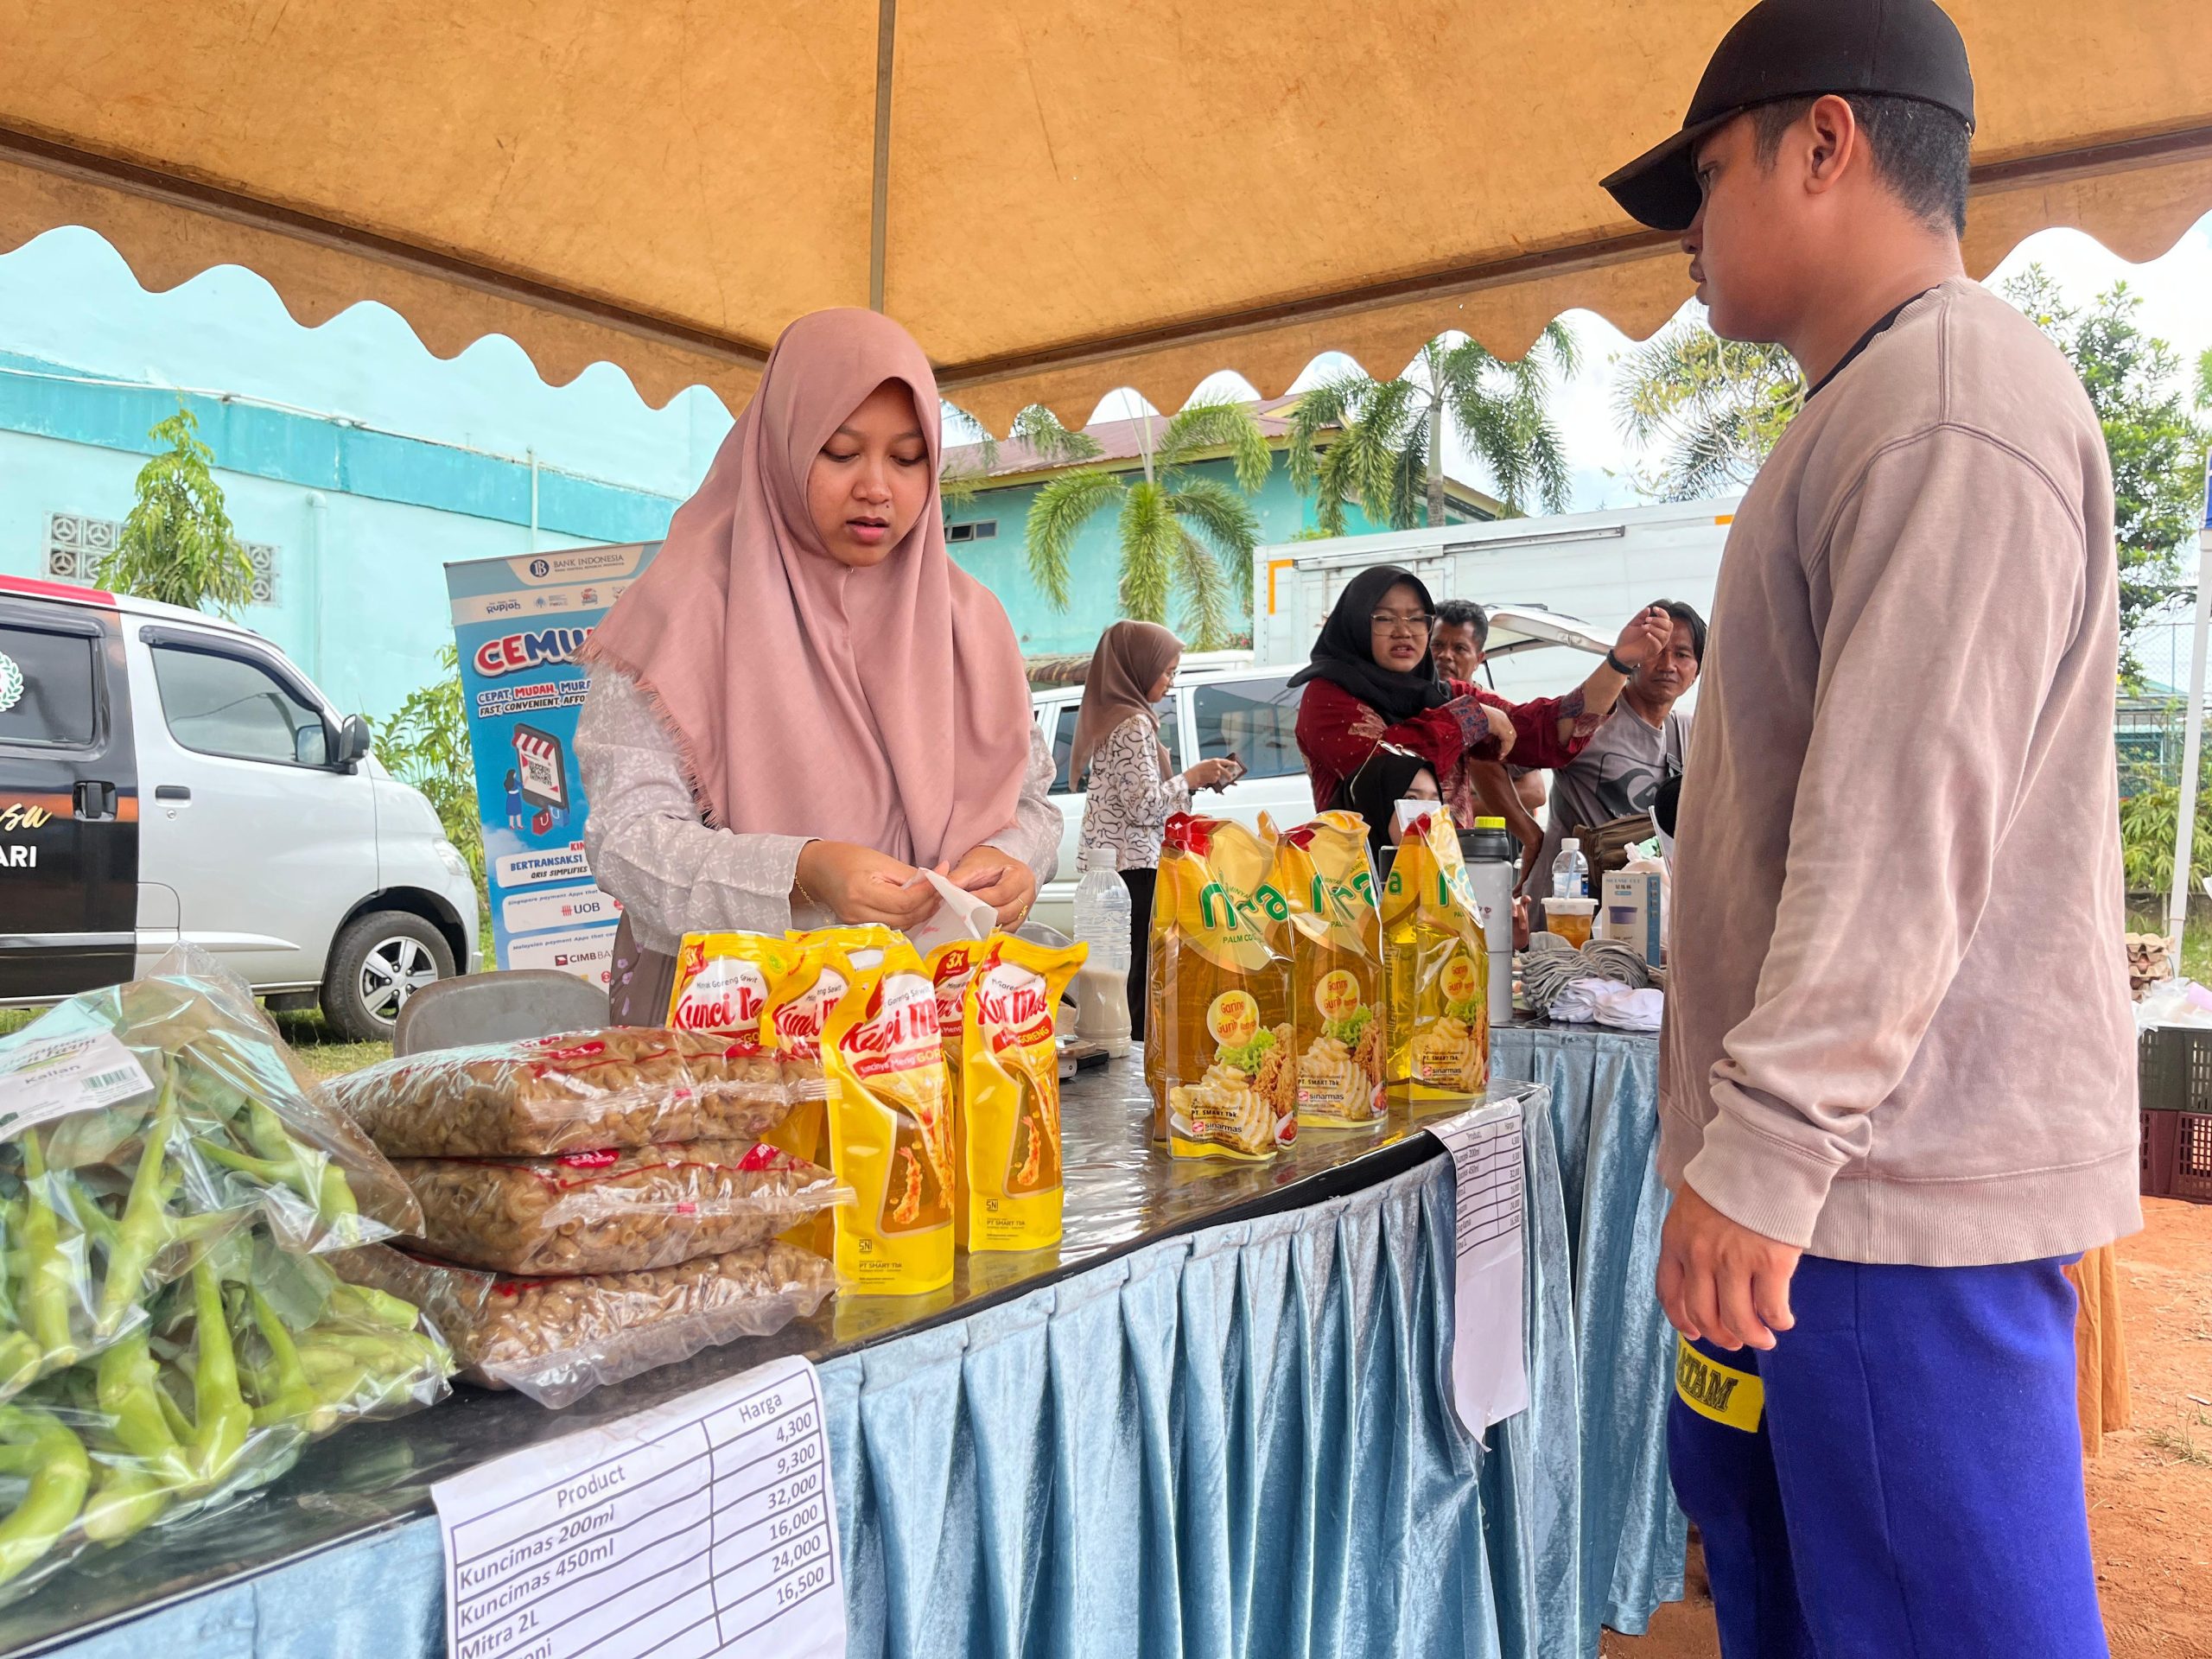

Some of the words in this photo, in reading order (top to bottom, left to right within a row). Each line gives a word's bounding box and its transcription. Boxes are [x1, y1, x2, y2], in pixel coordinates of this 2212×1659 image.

[554, 559, 575, 569] BANK
[578, 554, 624, 566] INDONESIA
[476, 629, 594, 673] CEMU
[479, 690, 512, 703] CEPAT,
[505, 697, 561, 712] CONVENIENT,
[511, 854, 583, 872] BERTRANSAKSI
[531, 870, 548, 880] QRIS
[550, 866, 588, 877] SIMPLIFIES
[574, 902, 601, 914] UOB
[1223, 935, 1243, 944] PALM
[569, 951, 596, 963] CIMB
[945, 951, 964, 969] 3X
[1020, 1025, 1050, 1044] GORENG
[1205, 1122, 1243, 1133] sinarmas
[557, 1465, 626, 1510] Product
[739, 1394, 782, 1424] Harga
[460, 1536, 553, 1591] Kuncimas
[557, 1503, 614, 1545] 200ml
[776, 1412, 812, 1444] 4,300
[769, 1503, 818, 1541] 16,000
[461, 1570, 551, 1629] Kuncimas
[555, 1537, 614, 1578] 450ml
[777, 1443, 816, 1475] 9,300
[772, 1535, 822, 1573] 24,000
[461, 1627, 513, 1659] Mitra
[518, 1609, 540, 1634] 2L
[767, 1473, 817, 1510] 32,000
[776, 1567, 825, 1606] 16,500
